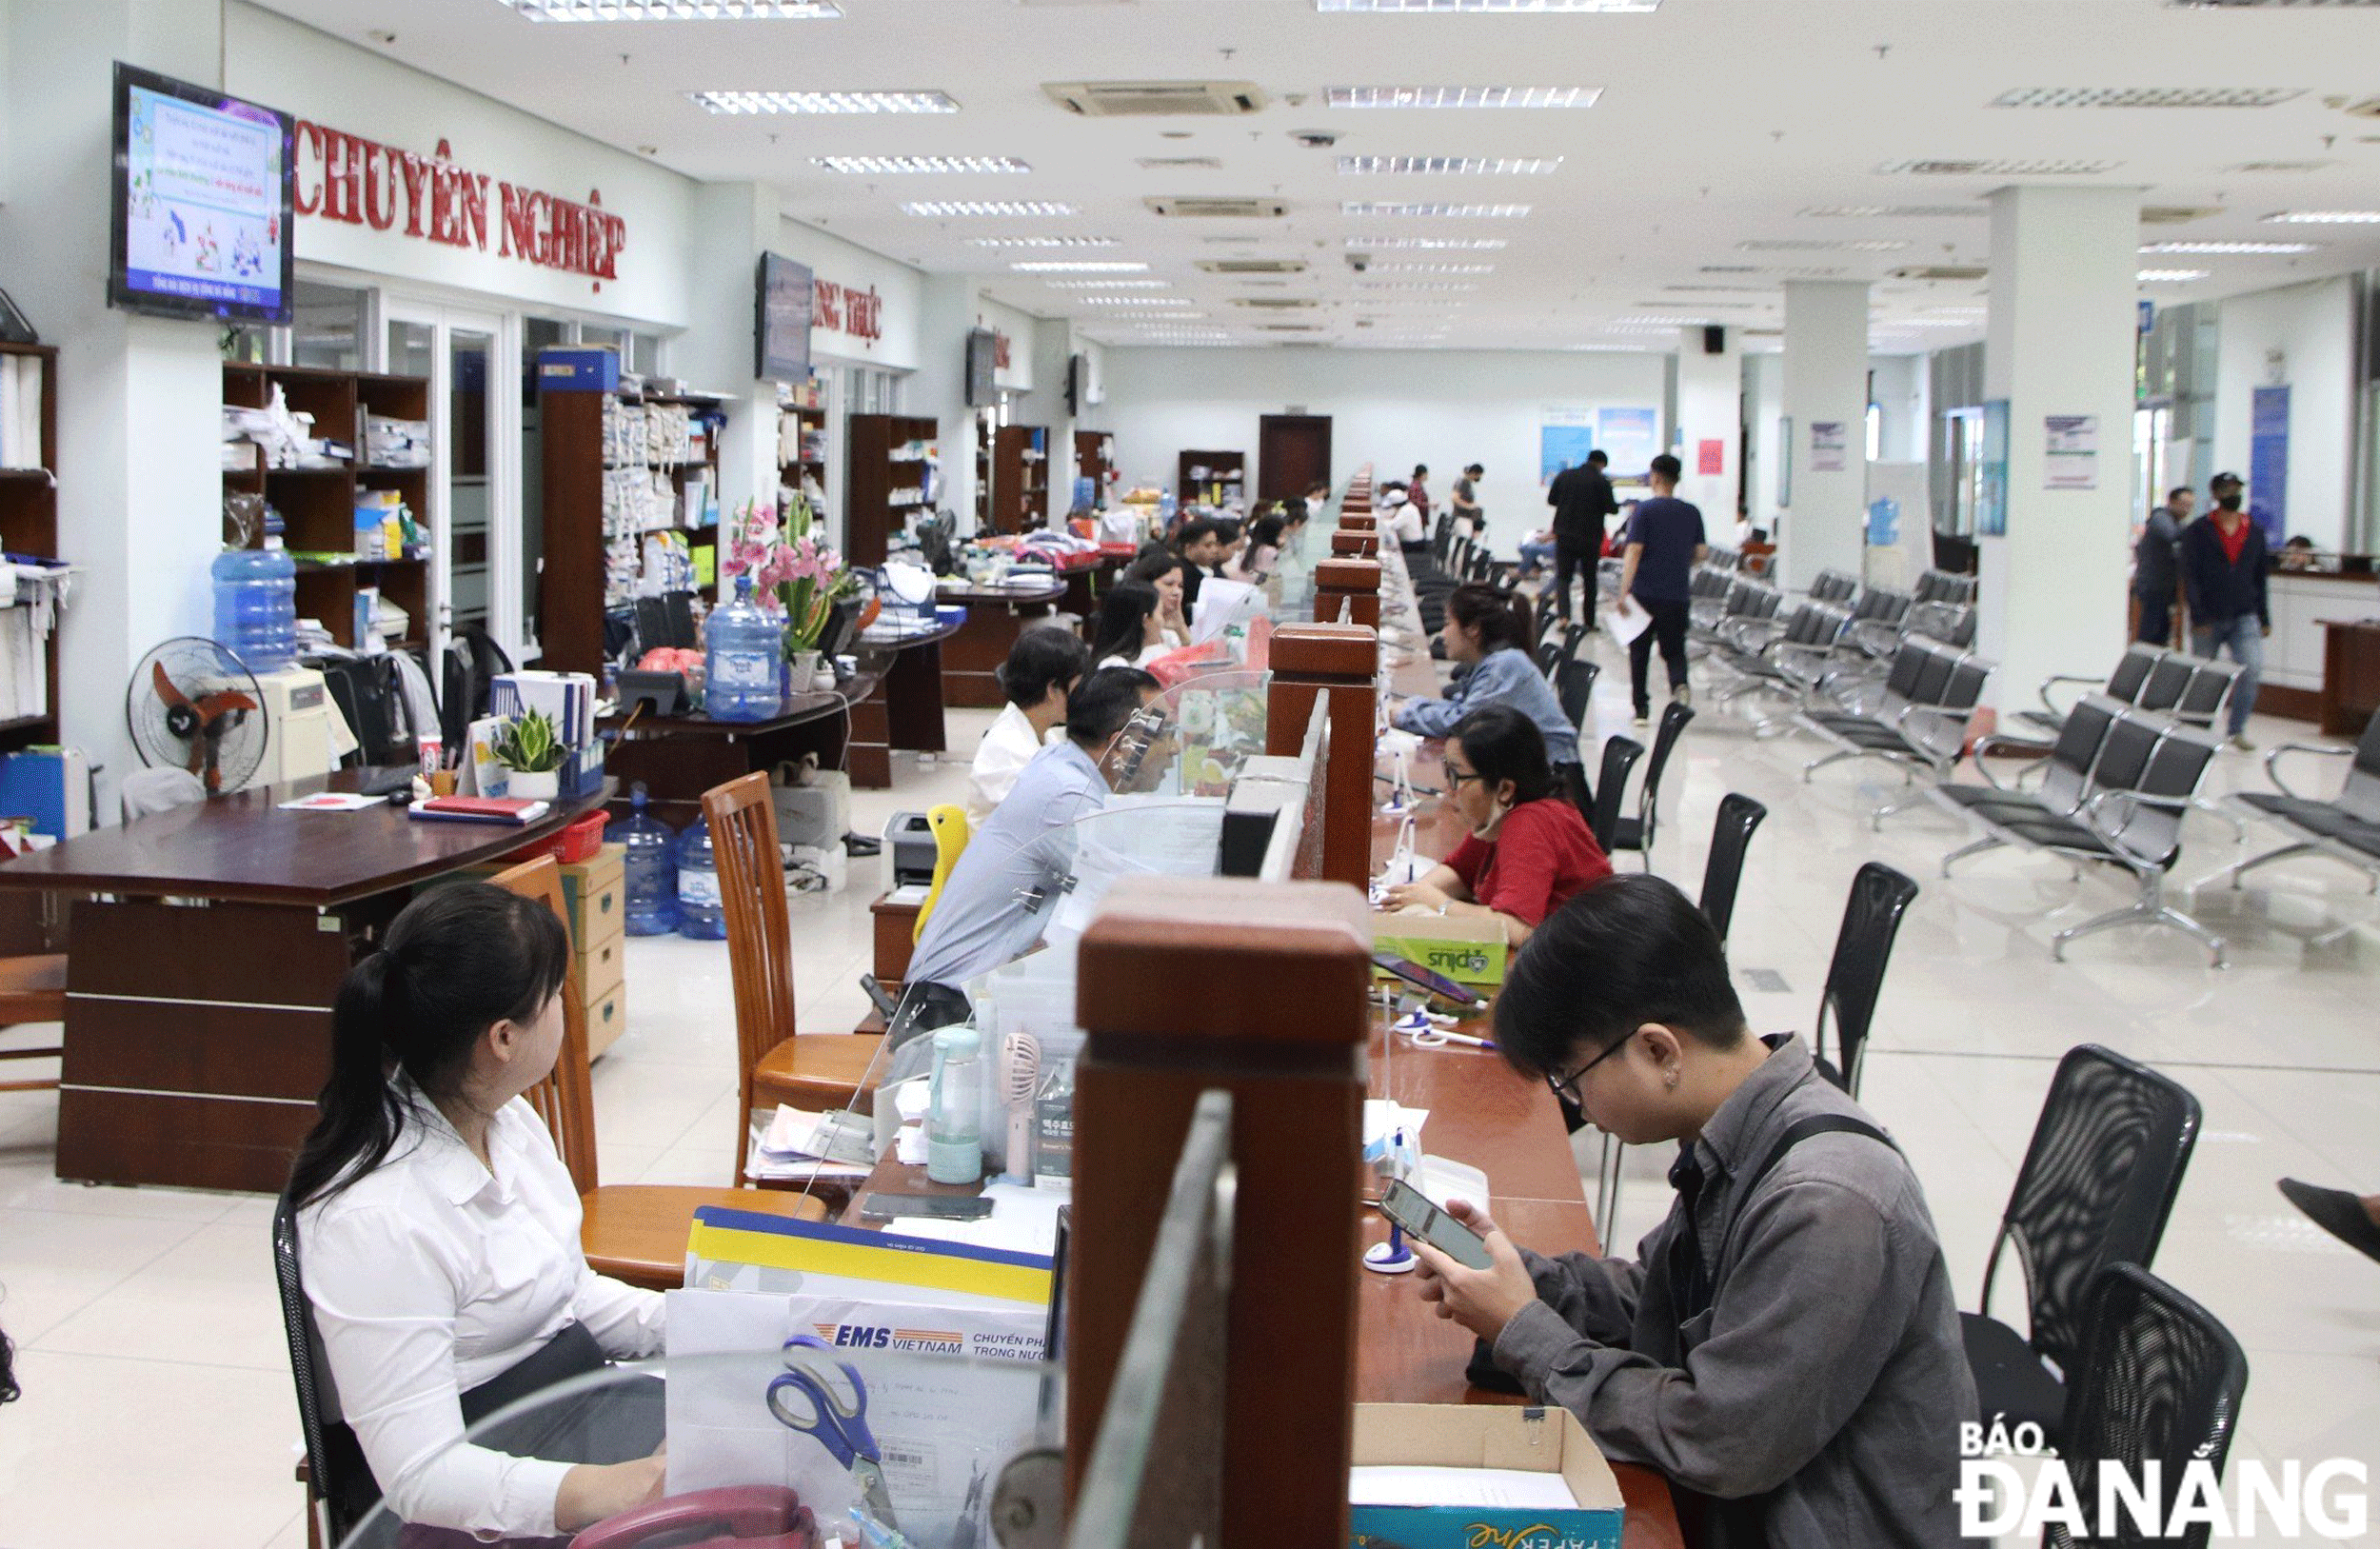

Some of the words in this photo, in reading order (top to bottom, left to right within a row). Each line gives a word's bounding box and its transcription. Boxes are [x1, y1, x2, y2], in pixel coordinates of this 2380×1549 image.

[293, 120, 491, 250] CHUYÊN
[498, 181, 625, 292] NGHIỆP
[835, 1325, 892, 1349] EMS
[1025, 1338, 1046, 1349] PH
[892, 1339, 962, 1355] VIETNAM
[974, 1345, 1016, 1360] TRONG
